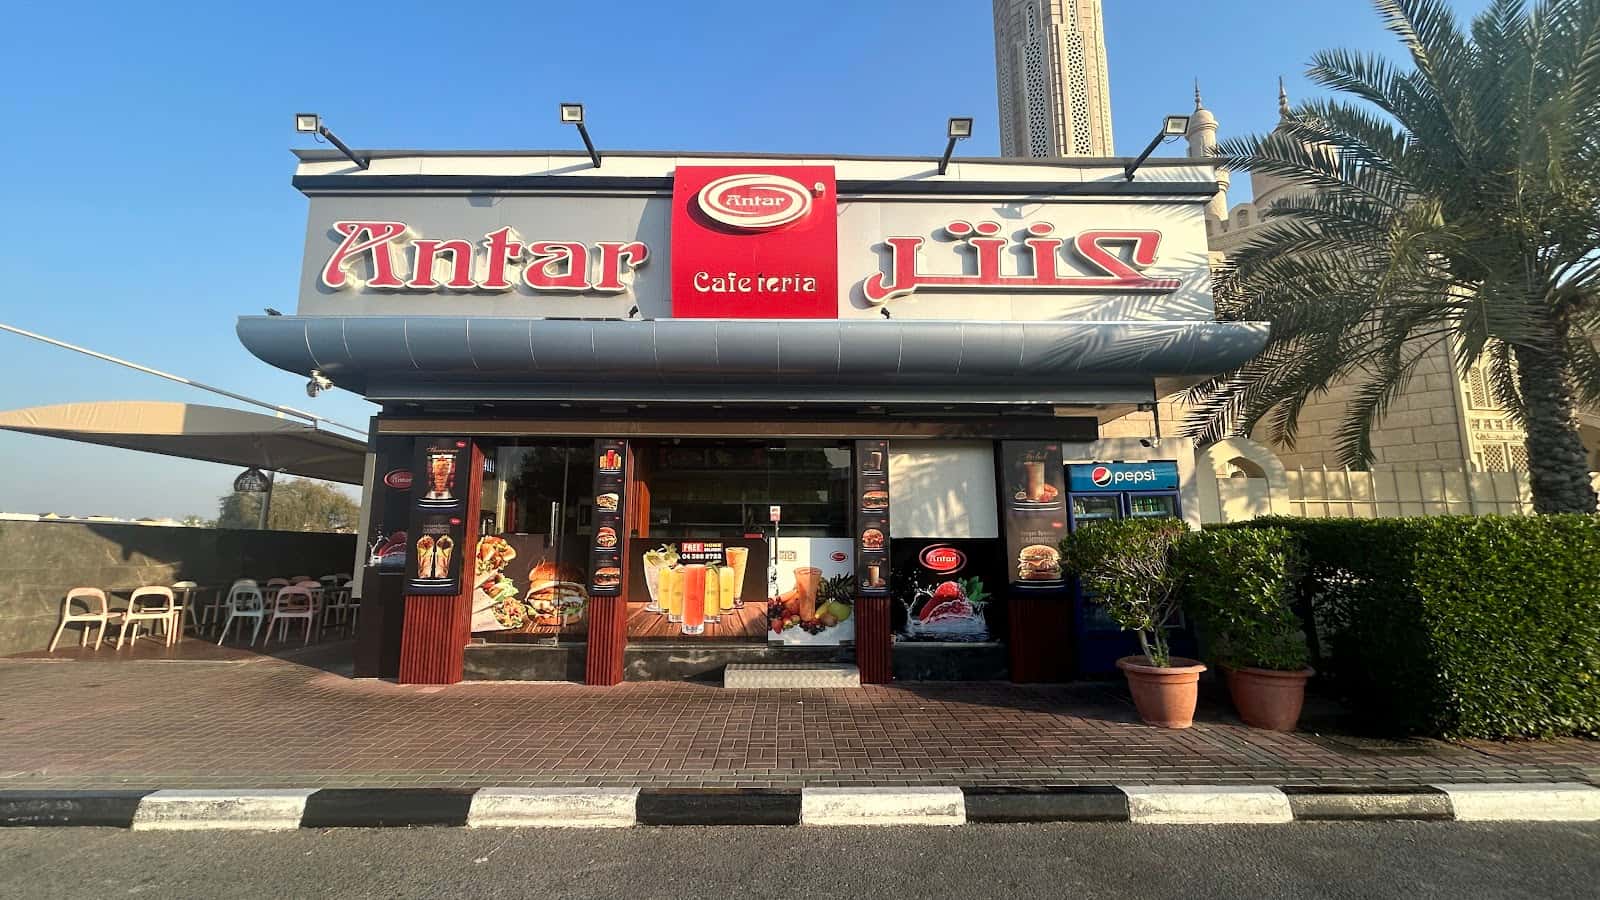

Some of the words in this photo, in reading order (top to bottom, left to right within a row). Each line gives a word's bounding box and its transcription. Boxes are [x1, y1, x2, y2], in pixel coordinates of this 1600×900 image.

[726, 194, 785, 207] Antar
[320, 220, 649, 293] Antar
[1114, 469, 1157, 484] pepsi
[683, 543, 702, 552] FREE
[929, 554, 956, 562] Antar
